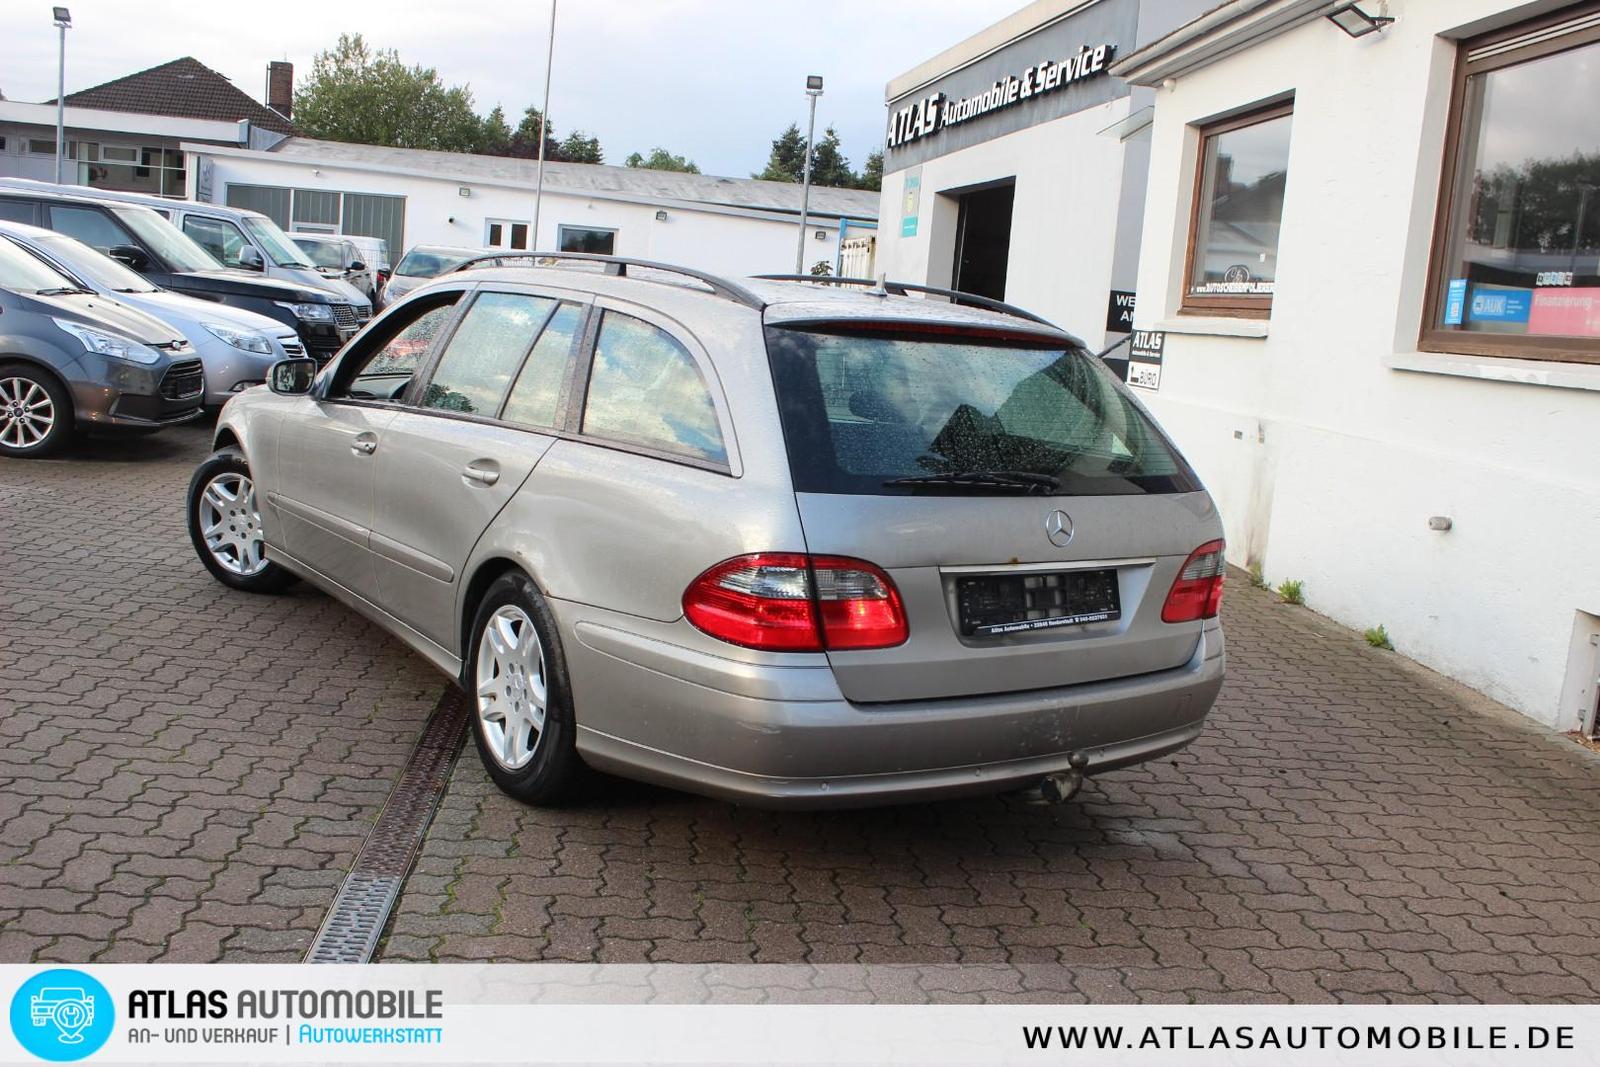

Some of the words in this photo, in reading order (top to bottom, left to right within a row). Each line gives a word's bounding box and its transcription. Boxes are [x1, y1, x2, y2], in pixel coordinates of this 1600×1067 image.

[886, 92, 939, 148] ATLAS
[941, 76, 1020, 128] Automobile
[1020, 67, 1034, 97] &
[1034, 44, 1106, 93] Service
[1132, 331, 1162, 350] ATLAS
